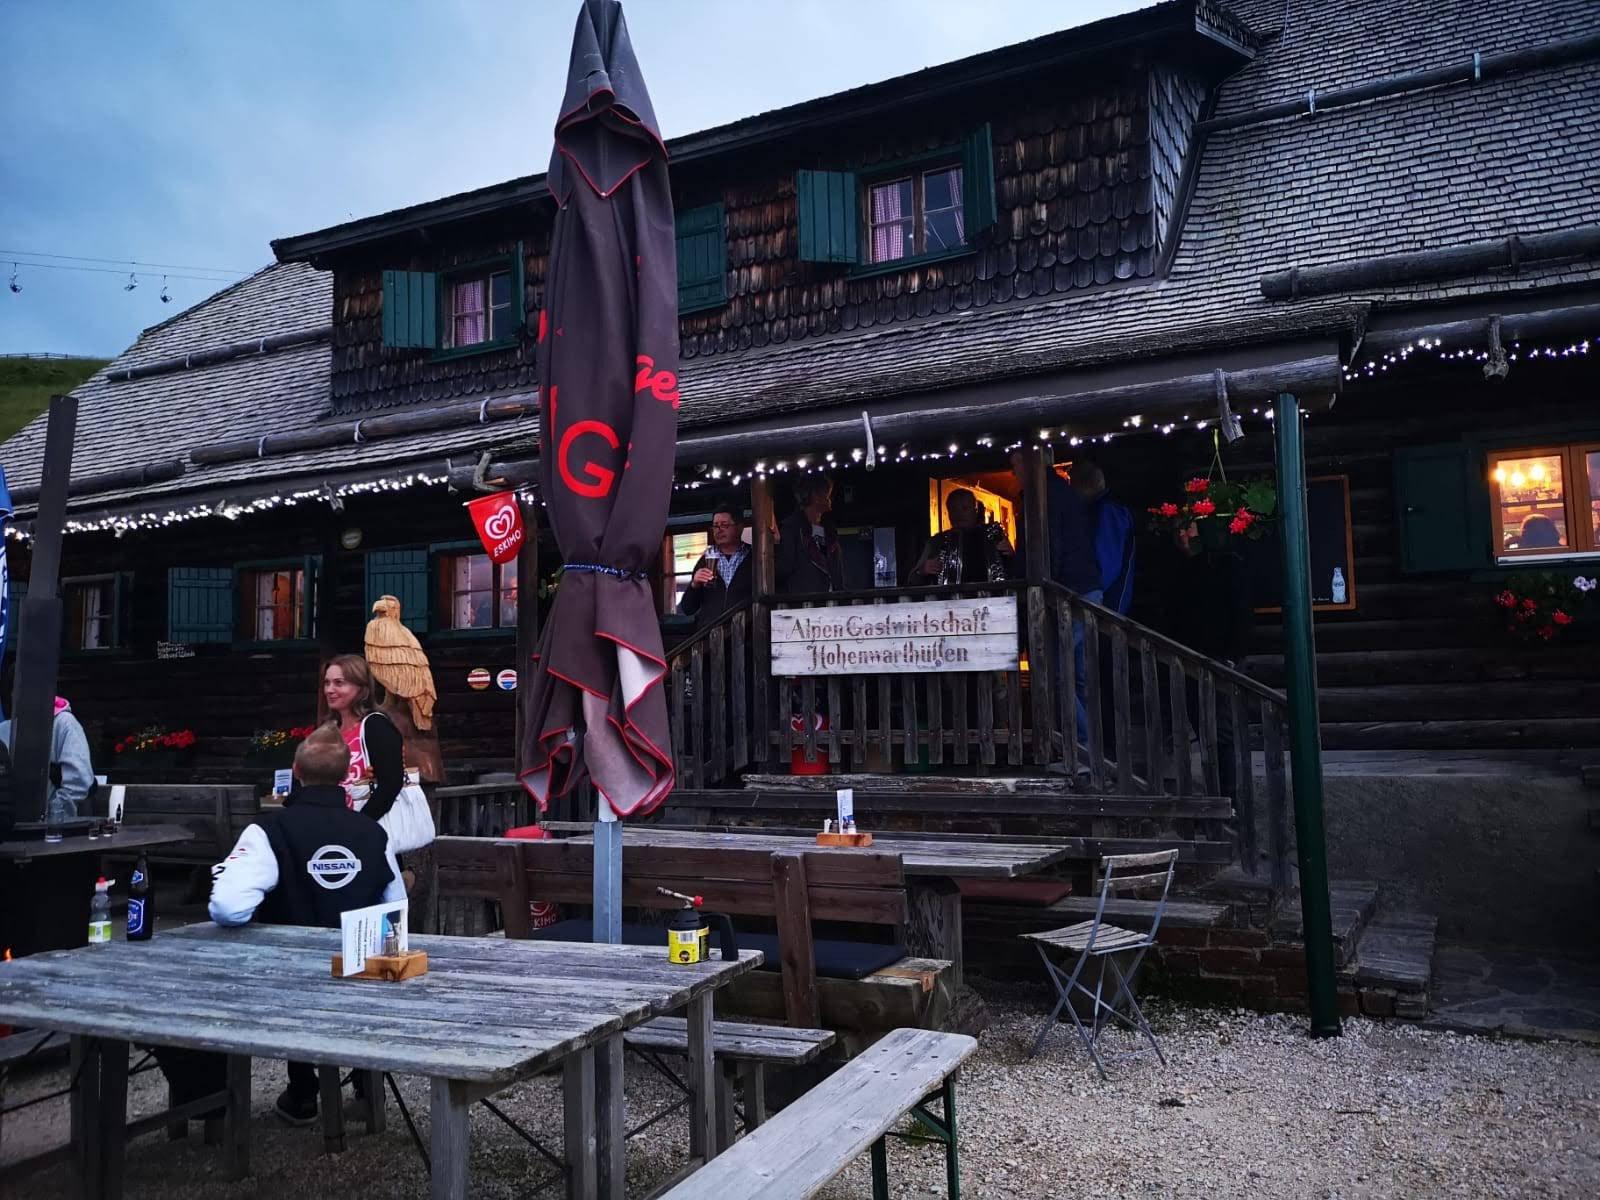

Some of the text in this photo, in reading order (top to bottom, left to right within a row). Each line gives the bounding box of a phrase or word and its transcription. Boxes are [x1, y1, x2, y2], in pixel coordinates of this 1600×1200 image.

[494, 530, 521, 557] ESKIMO
[786, 617, 843, 643] Alpen
[312, 862, 355, 871] NISSAN
